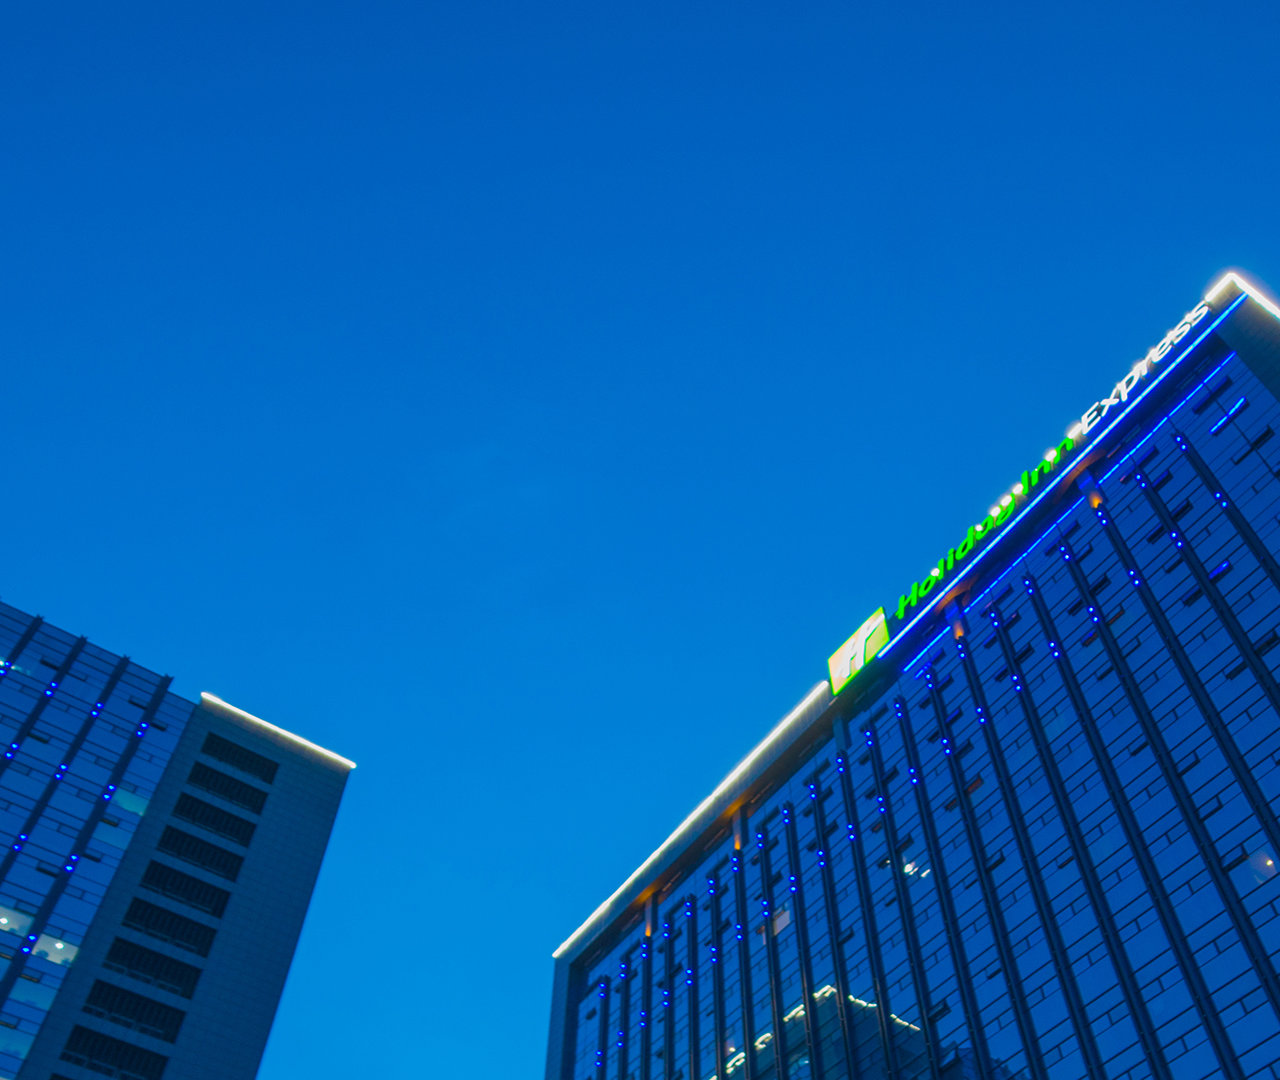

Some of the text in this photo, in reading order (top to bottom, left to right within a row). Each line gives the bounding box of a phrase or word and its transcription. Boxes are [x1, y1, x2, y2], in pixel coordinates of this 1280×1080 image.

[894, 299, 1210, 620] Holiday Inn Express
